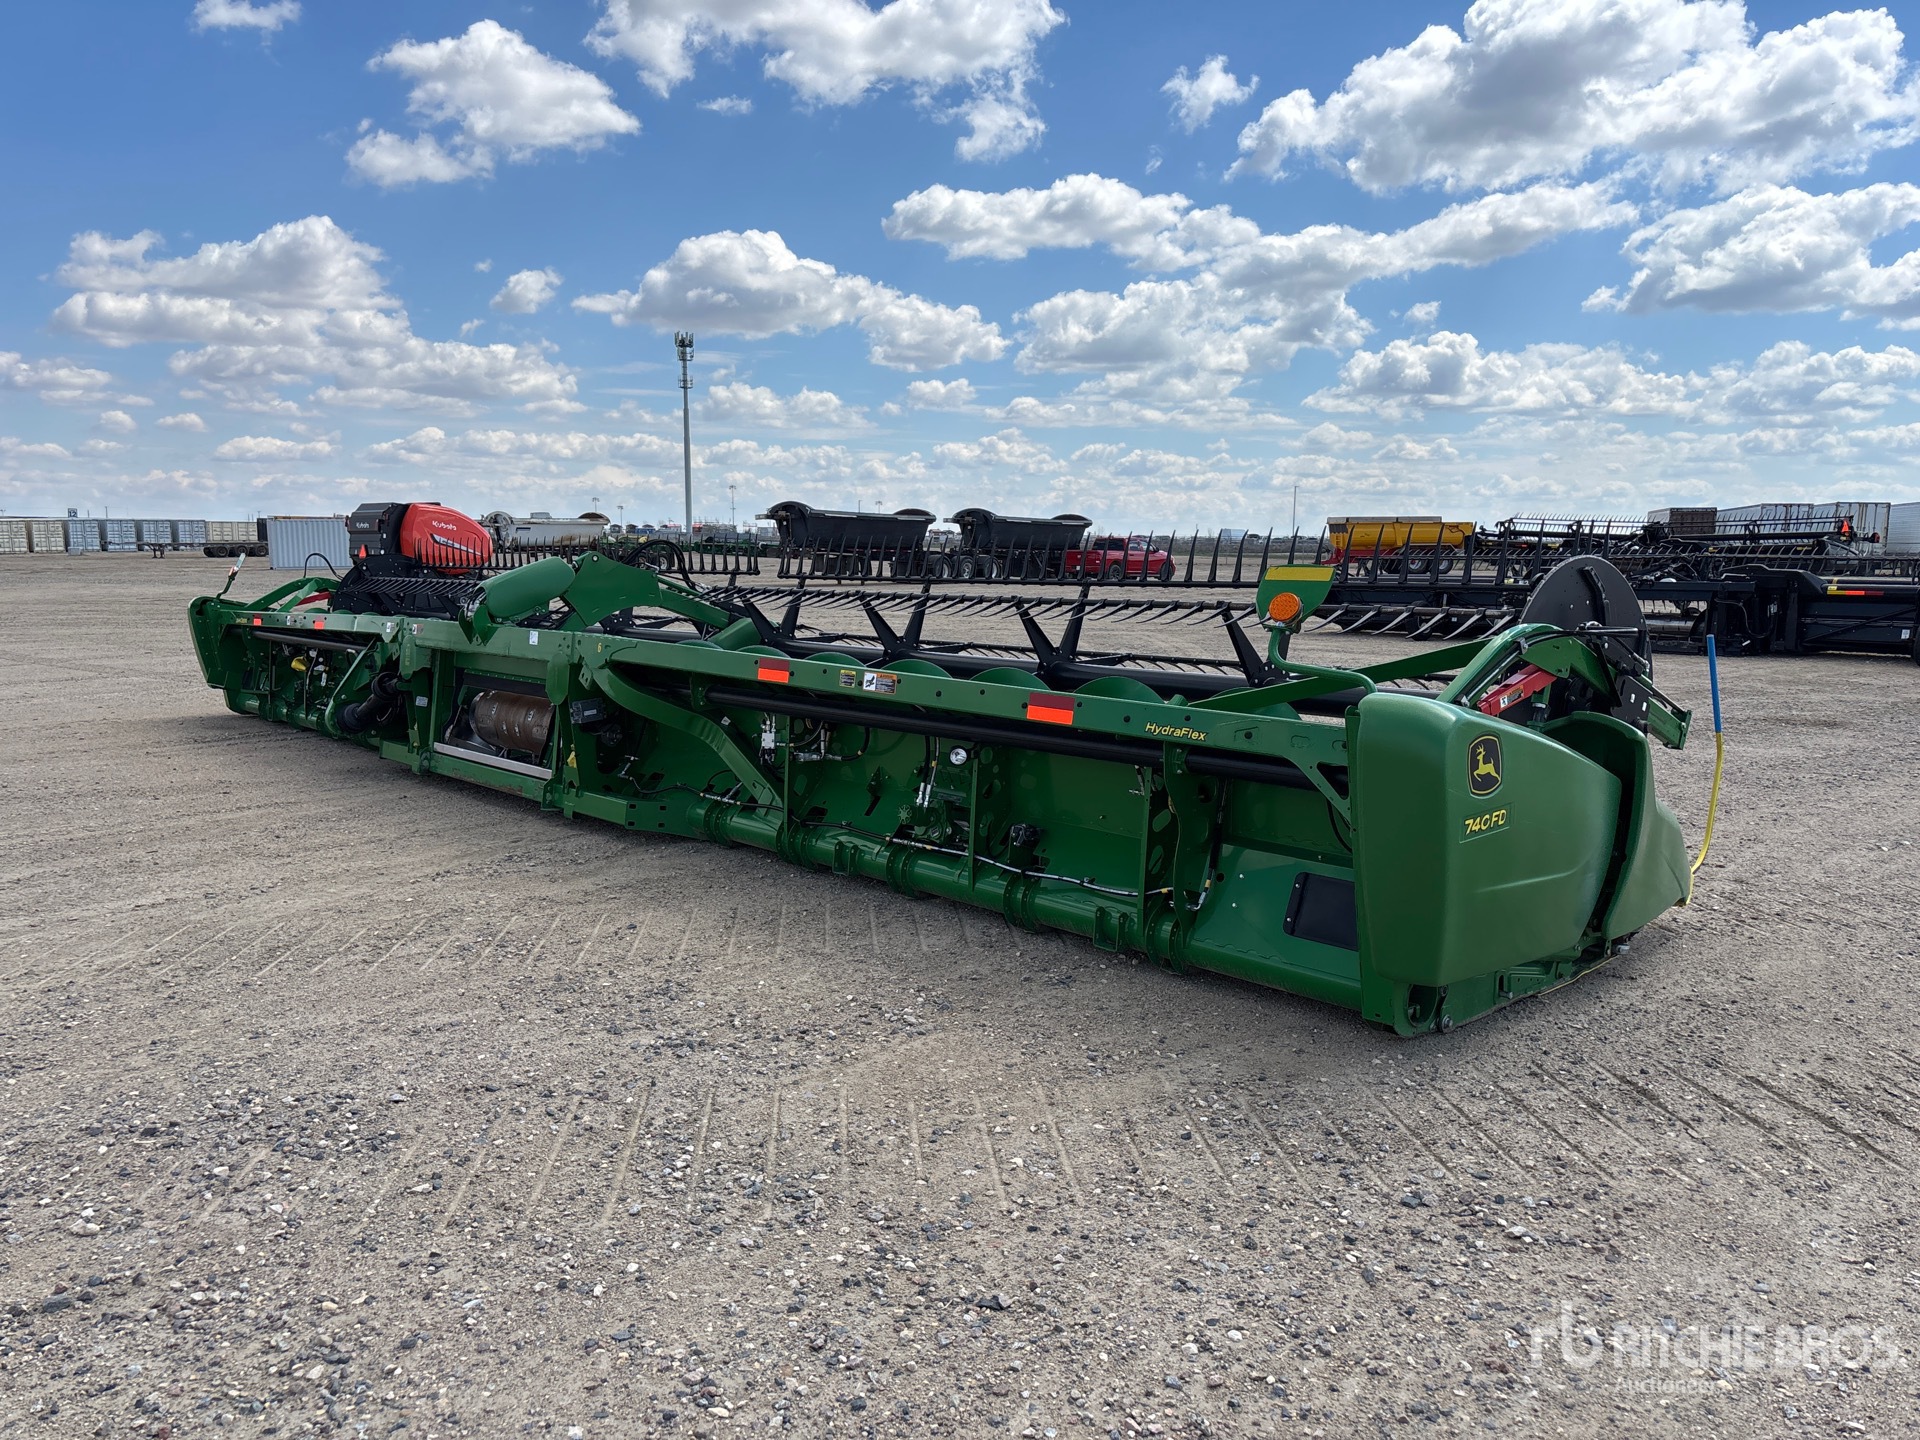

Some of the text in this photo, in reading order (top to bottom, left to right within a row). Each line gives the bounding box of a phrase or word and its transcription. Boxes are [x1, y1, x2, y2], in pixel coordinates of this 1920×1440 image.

[432, 520, 457, 531] Kubota
[1145, 722, 1207, 741] HydraFlex
[1464, 809, 1507, 836] 740FD
